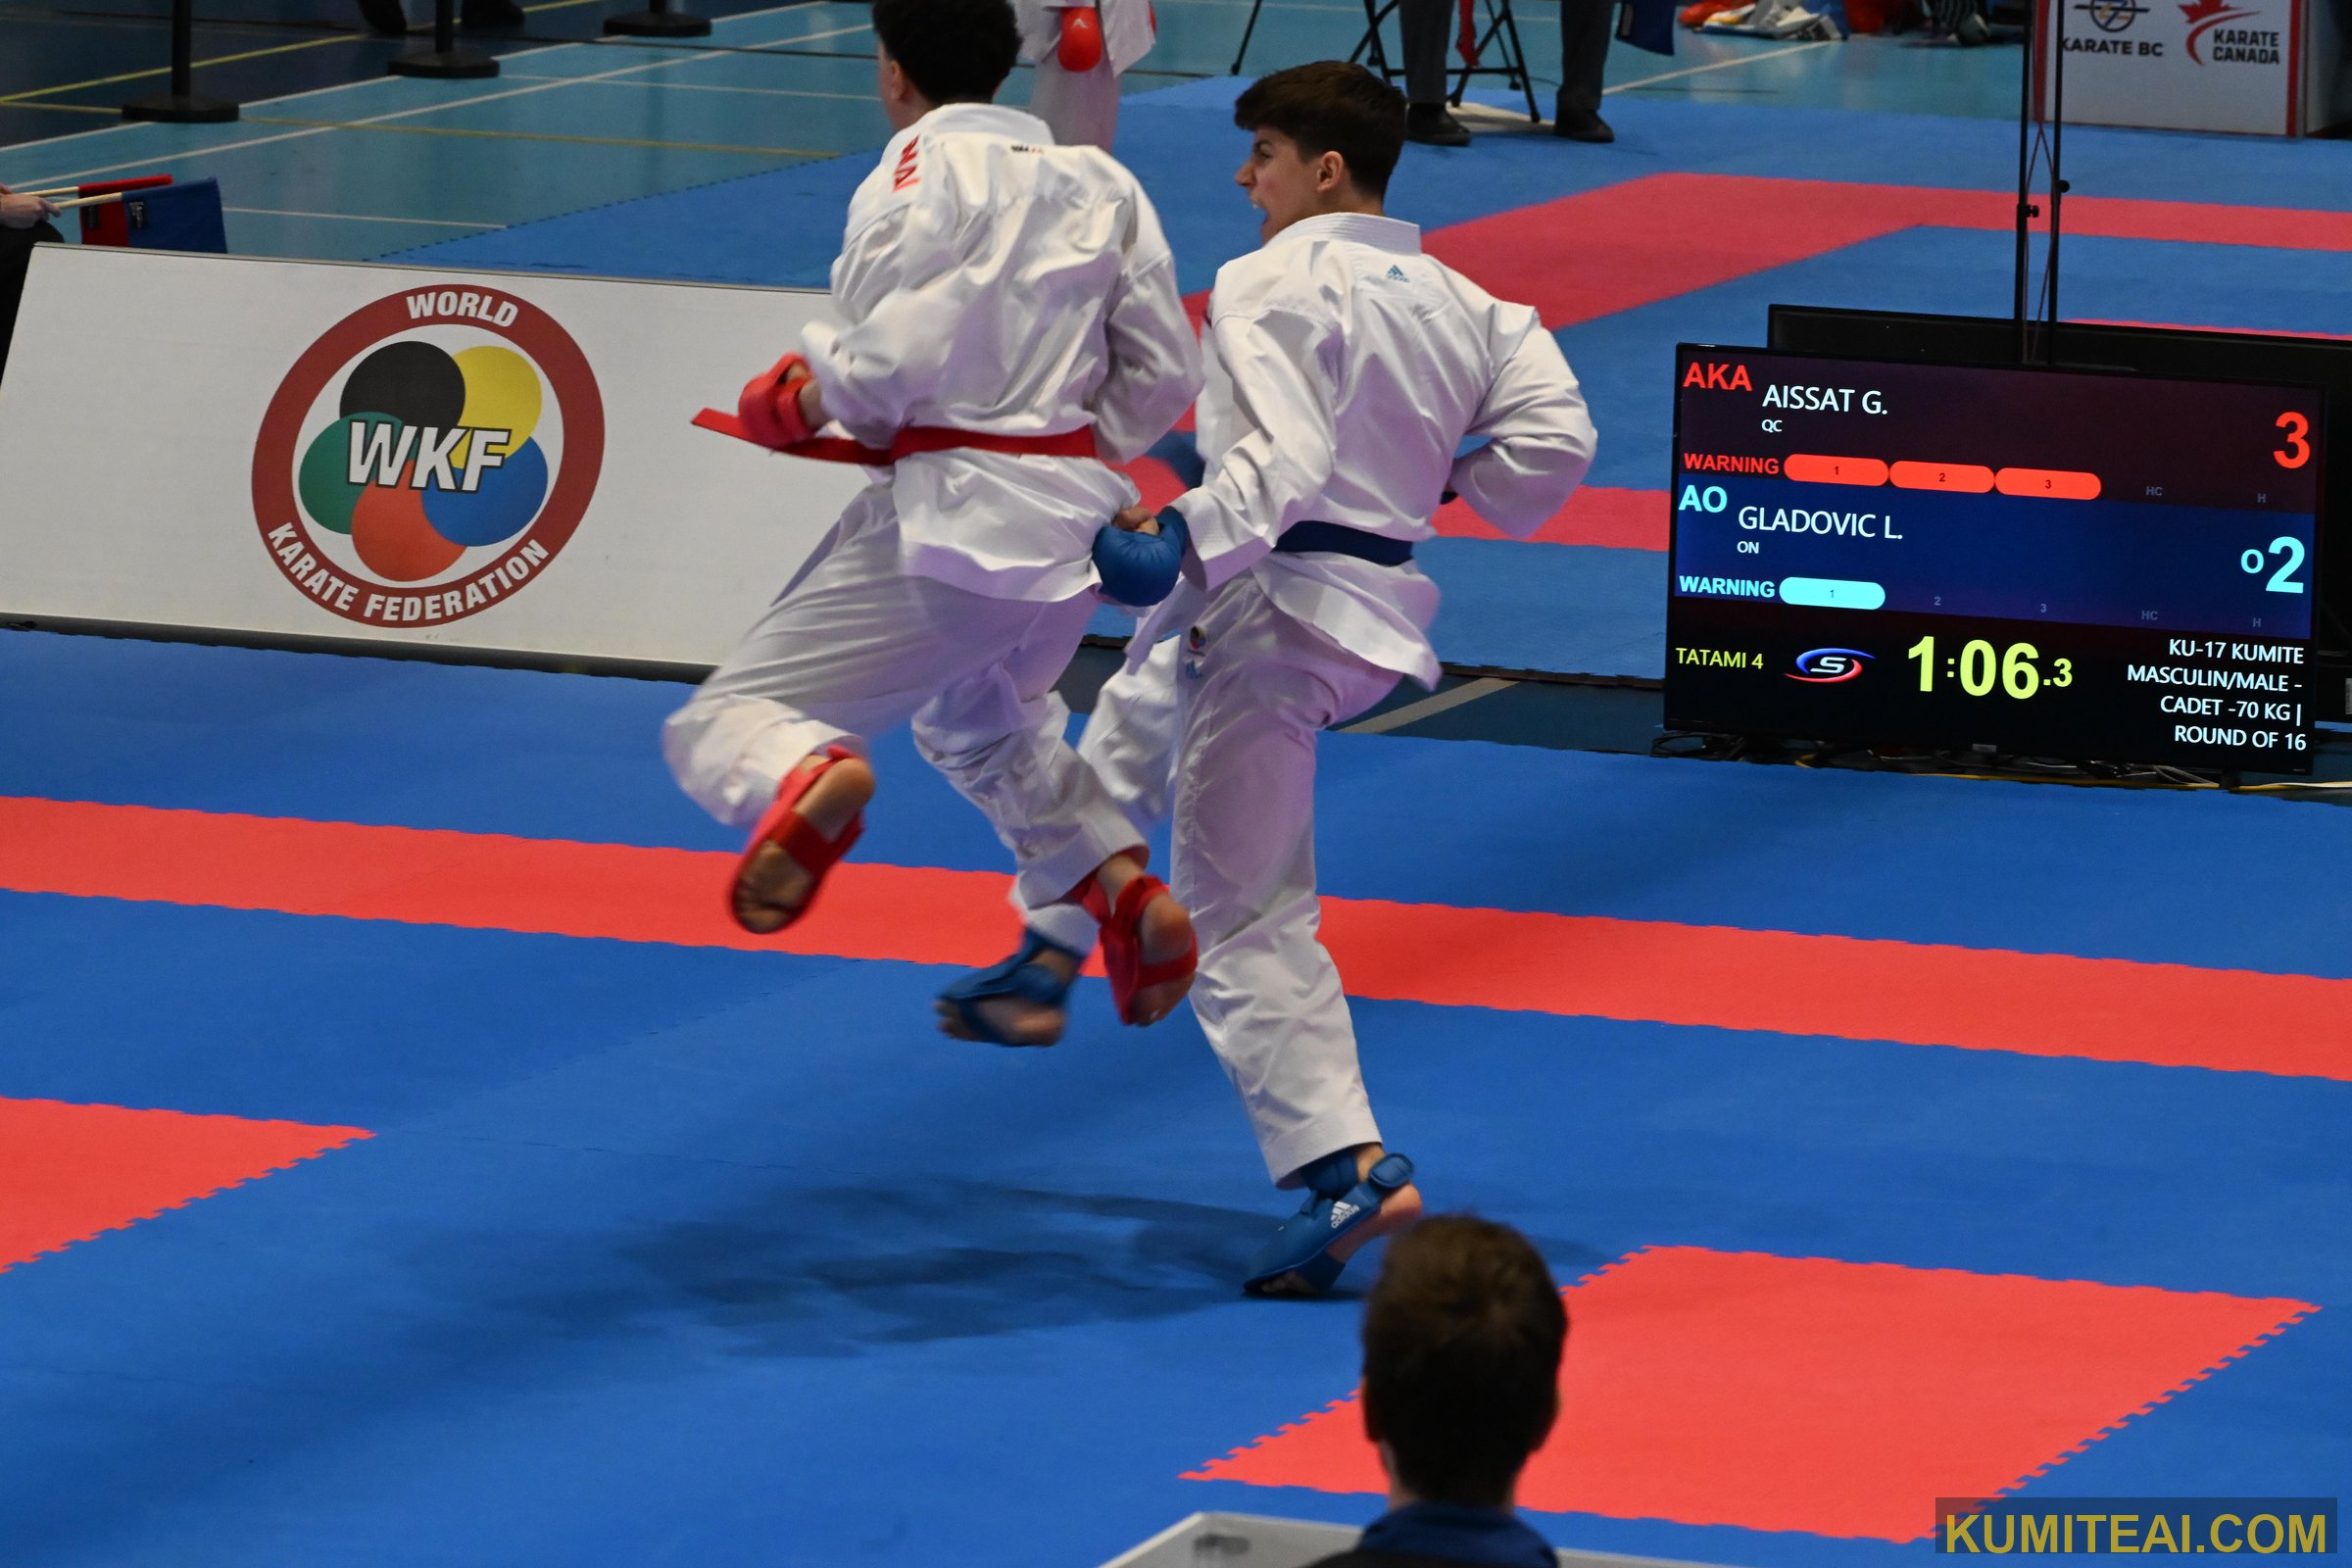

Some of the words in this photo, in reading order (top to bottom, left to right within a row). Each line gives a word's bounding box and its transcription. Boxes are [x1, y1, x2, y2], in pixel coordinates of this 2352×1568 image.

[2062, 37, 2132, 55] KARATE
[2138, 42, 2164, 57] BC
[2214, 28, 2279, 47] KARATE
[2213, 46, 2280, 65] CANADA
[406, 291, 518, 328] WORLD
[1683, 362, 1752, 391] AKA
[1762, 384, 1855, 412] AISSAT
[1862, 390, 1888, 416] G.
[1761, 418, 1783, 433] QC
[2274, 412, 2311, 469] 3
[346, 420, 512, 493] WKF
[1684, 453, 1780, 475] WARNING
[1834, 466, 1839, 476] 1
[1938, 472, 1946, 483] 2
[2044, 479, 2052, 490] 3
[2145, 486, 2163, 497] HC
[2257, 493, 2266, 504] H
[1678, 484, 1728, 514] AO
[1739, 506, 1877, 538] GLADOVIC
[1885, 515, 1903, 540] L.
[1737, 541, 1760, 555] ON
[268, 522, 359, 612] KARATE
[364, 539, 550, 623] FEDERATION
[1679, 575, 1776, 599] WARNING
[1829, 589, 1836, 599] 1
[1934, 596, 1941, 606] 2
[2040, 603, 2047, 613] 3
[2141, 611, 2159, 621] HC
[2253, 618, 2261, 628] H
[1676, 647, 1746, 668] TATAMI
[1751, 654, 1764, 669] 4
[2169, 639, 2227, 659] KU-17
[2231, 643, 2304, 664] KUMITE
[2127, 664, 2289, 692] MASCULIN/MALE
[2160, 695, 2224, 715] CADET
[2228, 701, 2259, 718] -70
[2264, 703, 2290, 720] KG
[2174, 725, 2246, 746] ROUND
[2252, 730, 2278, 749] OF
[2284, 733, 2307, 751] 16
